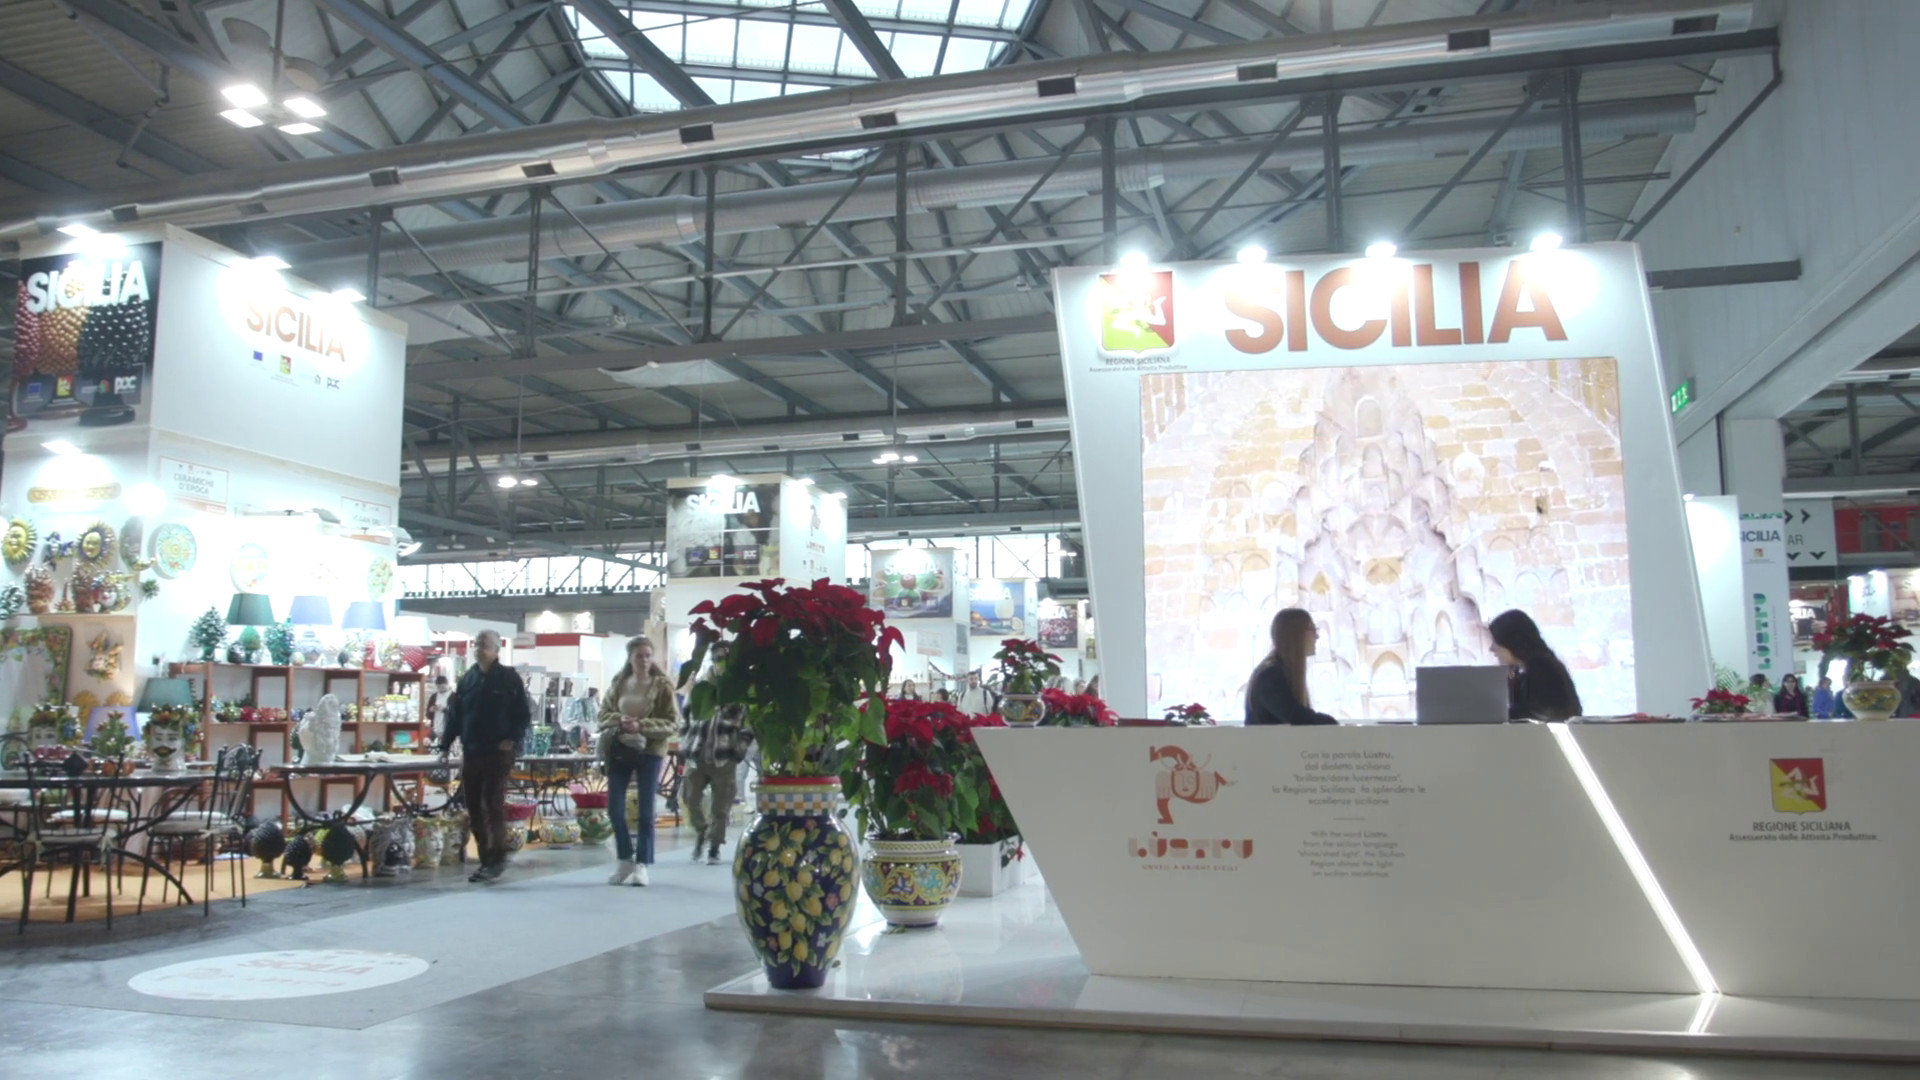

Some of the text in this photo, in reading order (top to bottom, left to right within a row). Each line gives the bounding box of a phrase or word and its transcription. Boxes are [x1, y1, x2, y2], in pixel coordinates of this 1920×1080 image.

[26, 261, 150, 314] SICILIA
[1224, 260, 1568, 354] SICILIA
[246, 300, 346, 363] SICILIA
[686, 492, 761, 515] SICILIA
[1741, 530, 1781, 543] ICILIA
[1753, 821, 1851, 832] REGIONE SICILIANA
